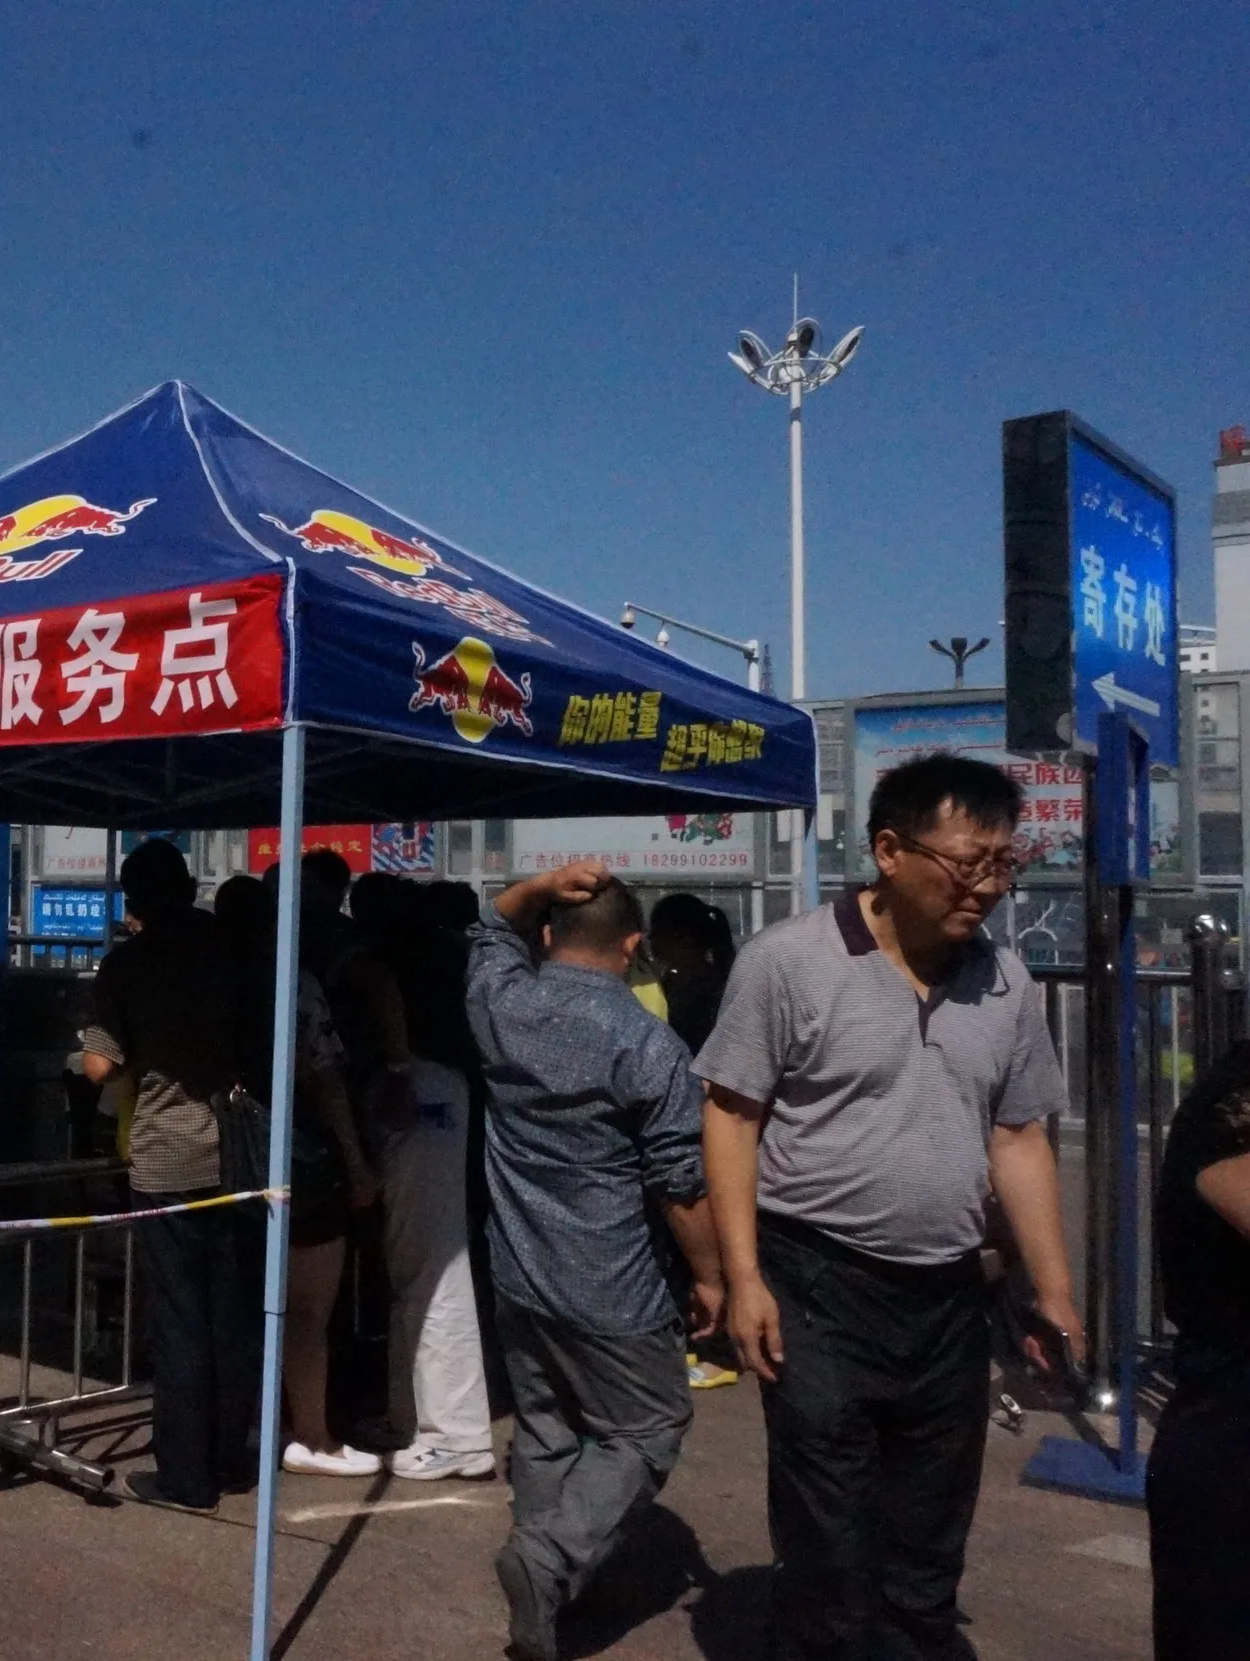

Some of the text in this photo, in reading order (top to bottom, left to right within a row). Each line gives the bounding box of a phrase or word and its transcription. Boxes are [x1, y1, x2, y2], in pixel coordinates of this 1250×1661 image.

[1079, 545, 1167, 667] 寄存处
[557, 690, 661, 747] 你的能量
[643, 853, 748, 867] 18299102299
[41, 902, 106, 918] 请勿乱扔垃
